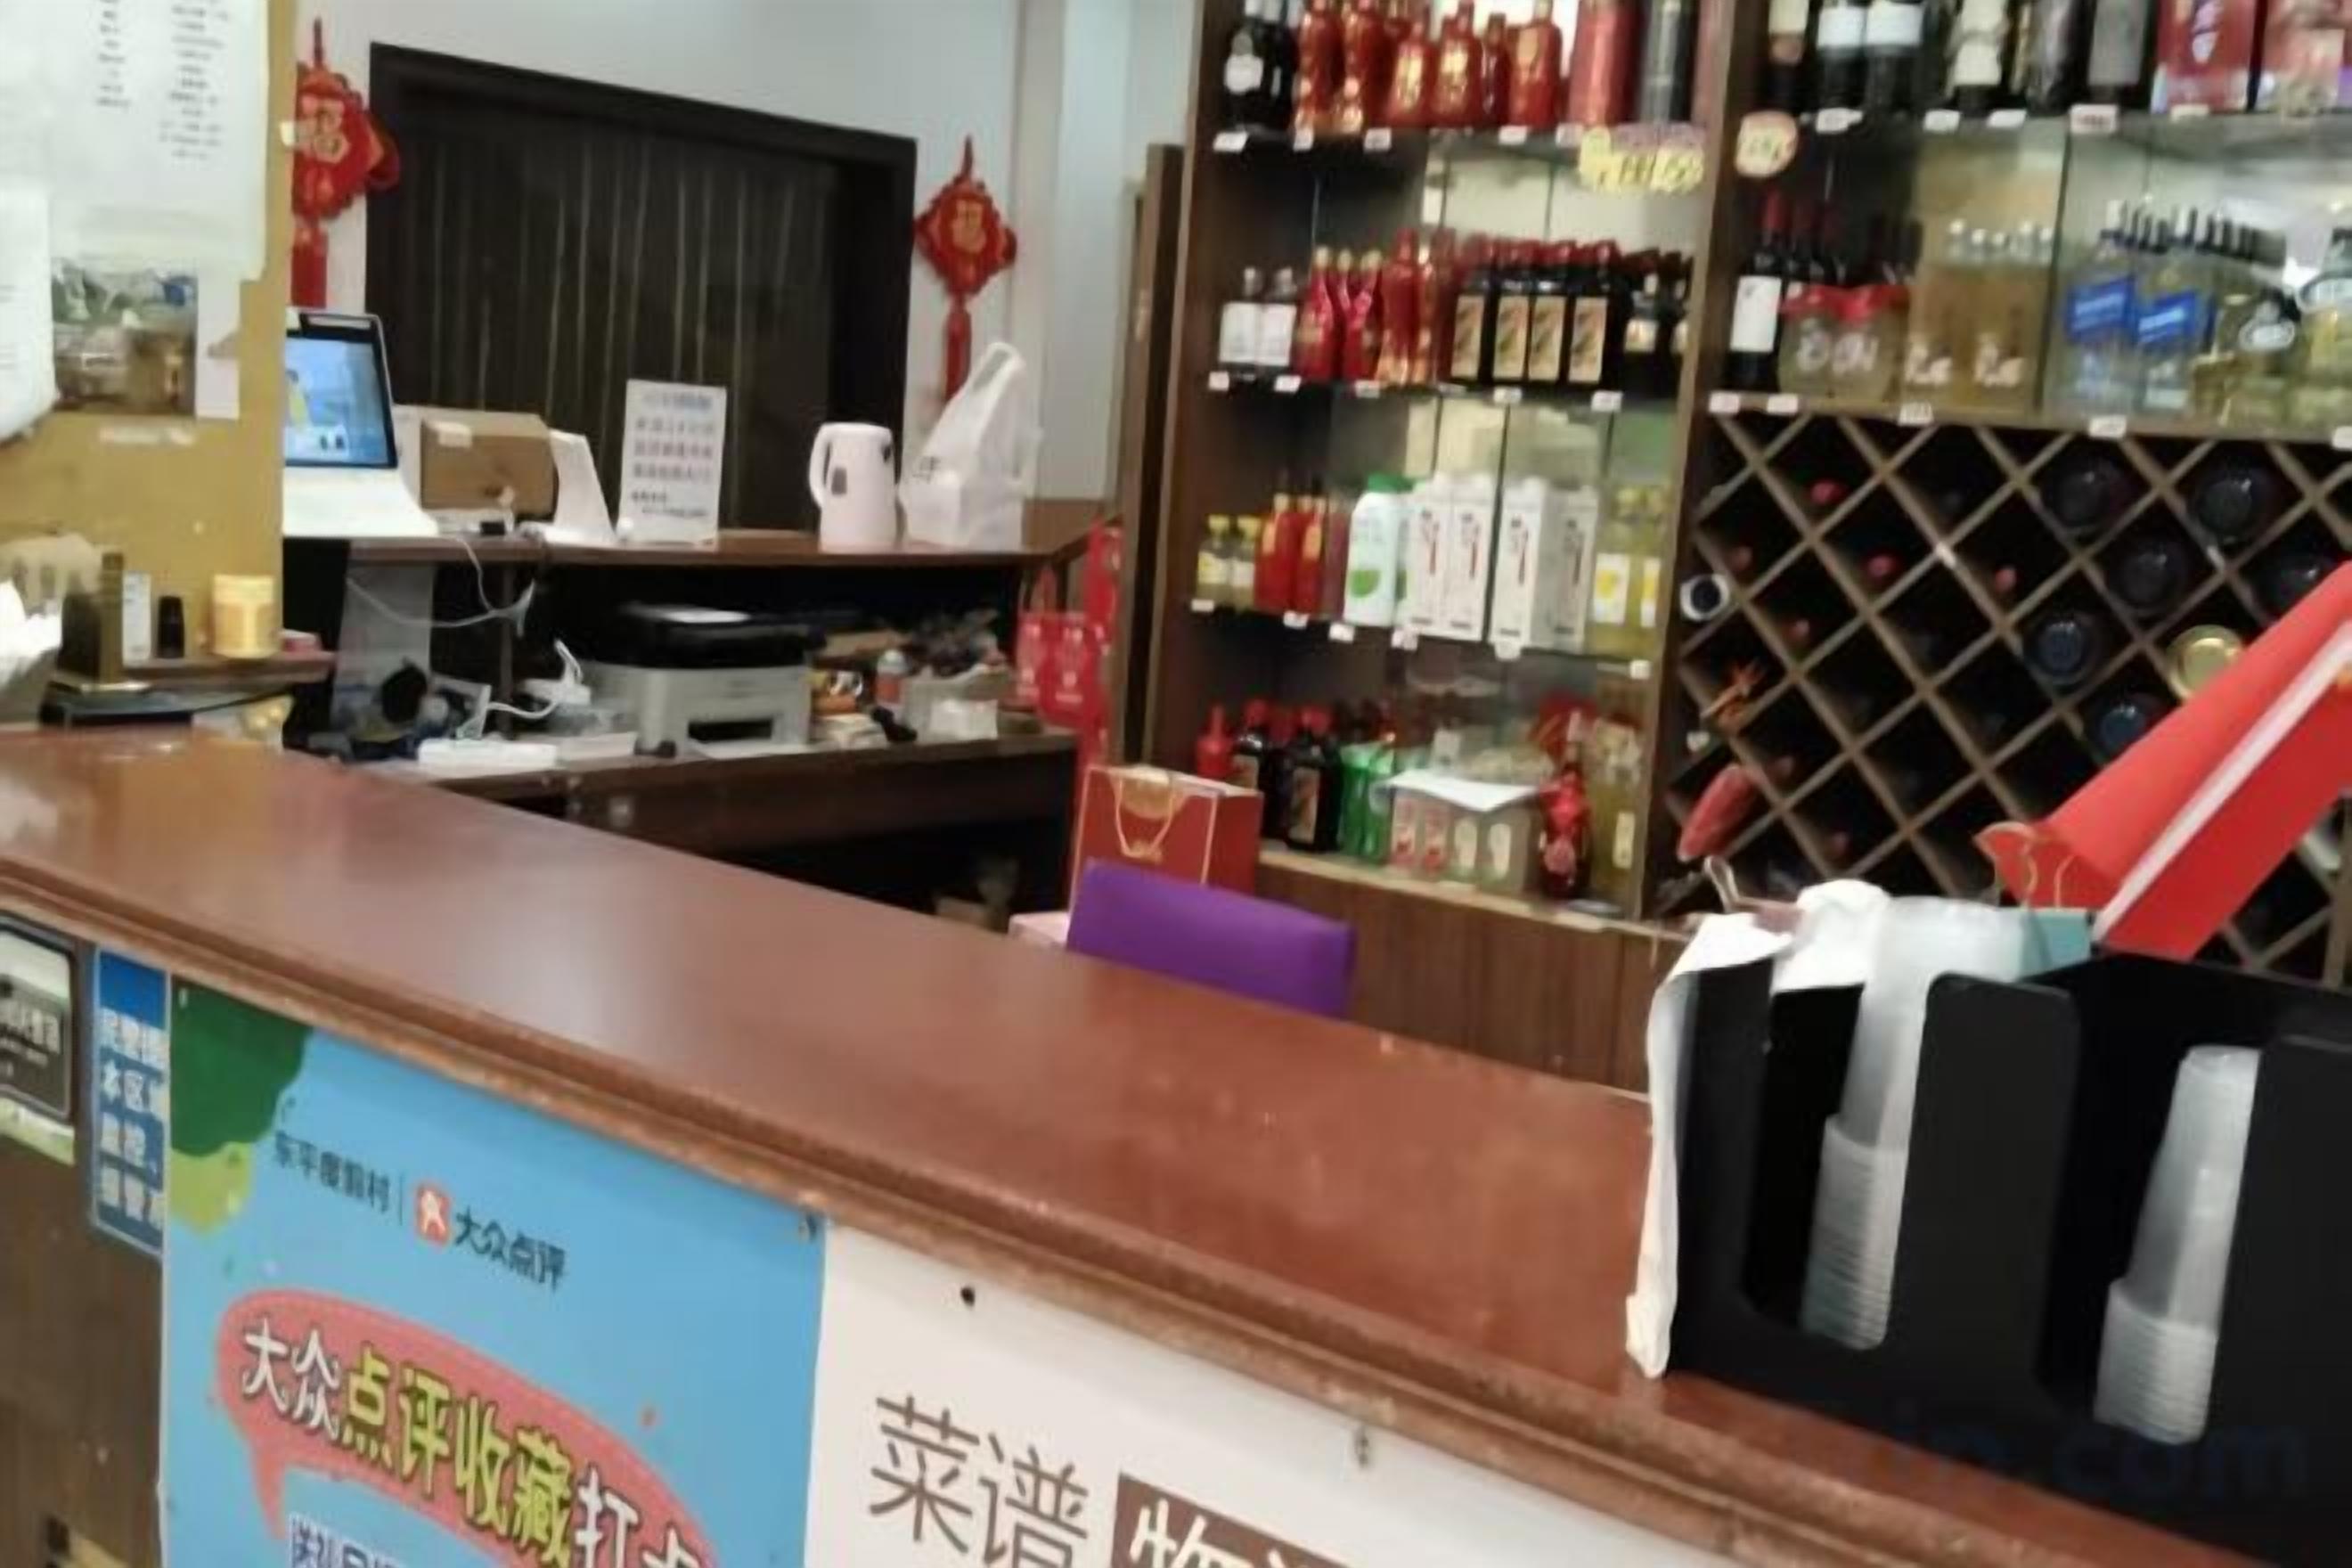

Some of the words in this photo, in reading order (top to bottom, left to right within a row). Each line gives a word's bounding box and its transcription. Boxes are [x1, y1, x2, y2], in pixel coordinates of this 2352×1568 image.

[454, 1207, 567, 1292] 大众点评
[869, 1395, 1089, 1568] 菜谱
